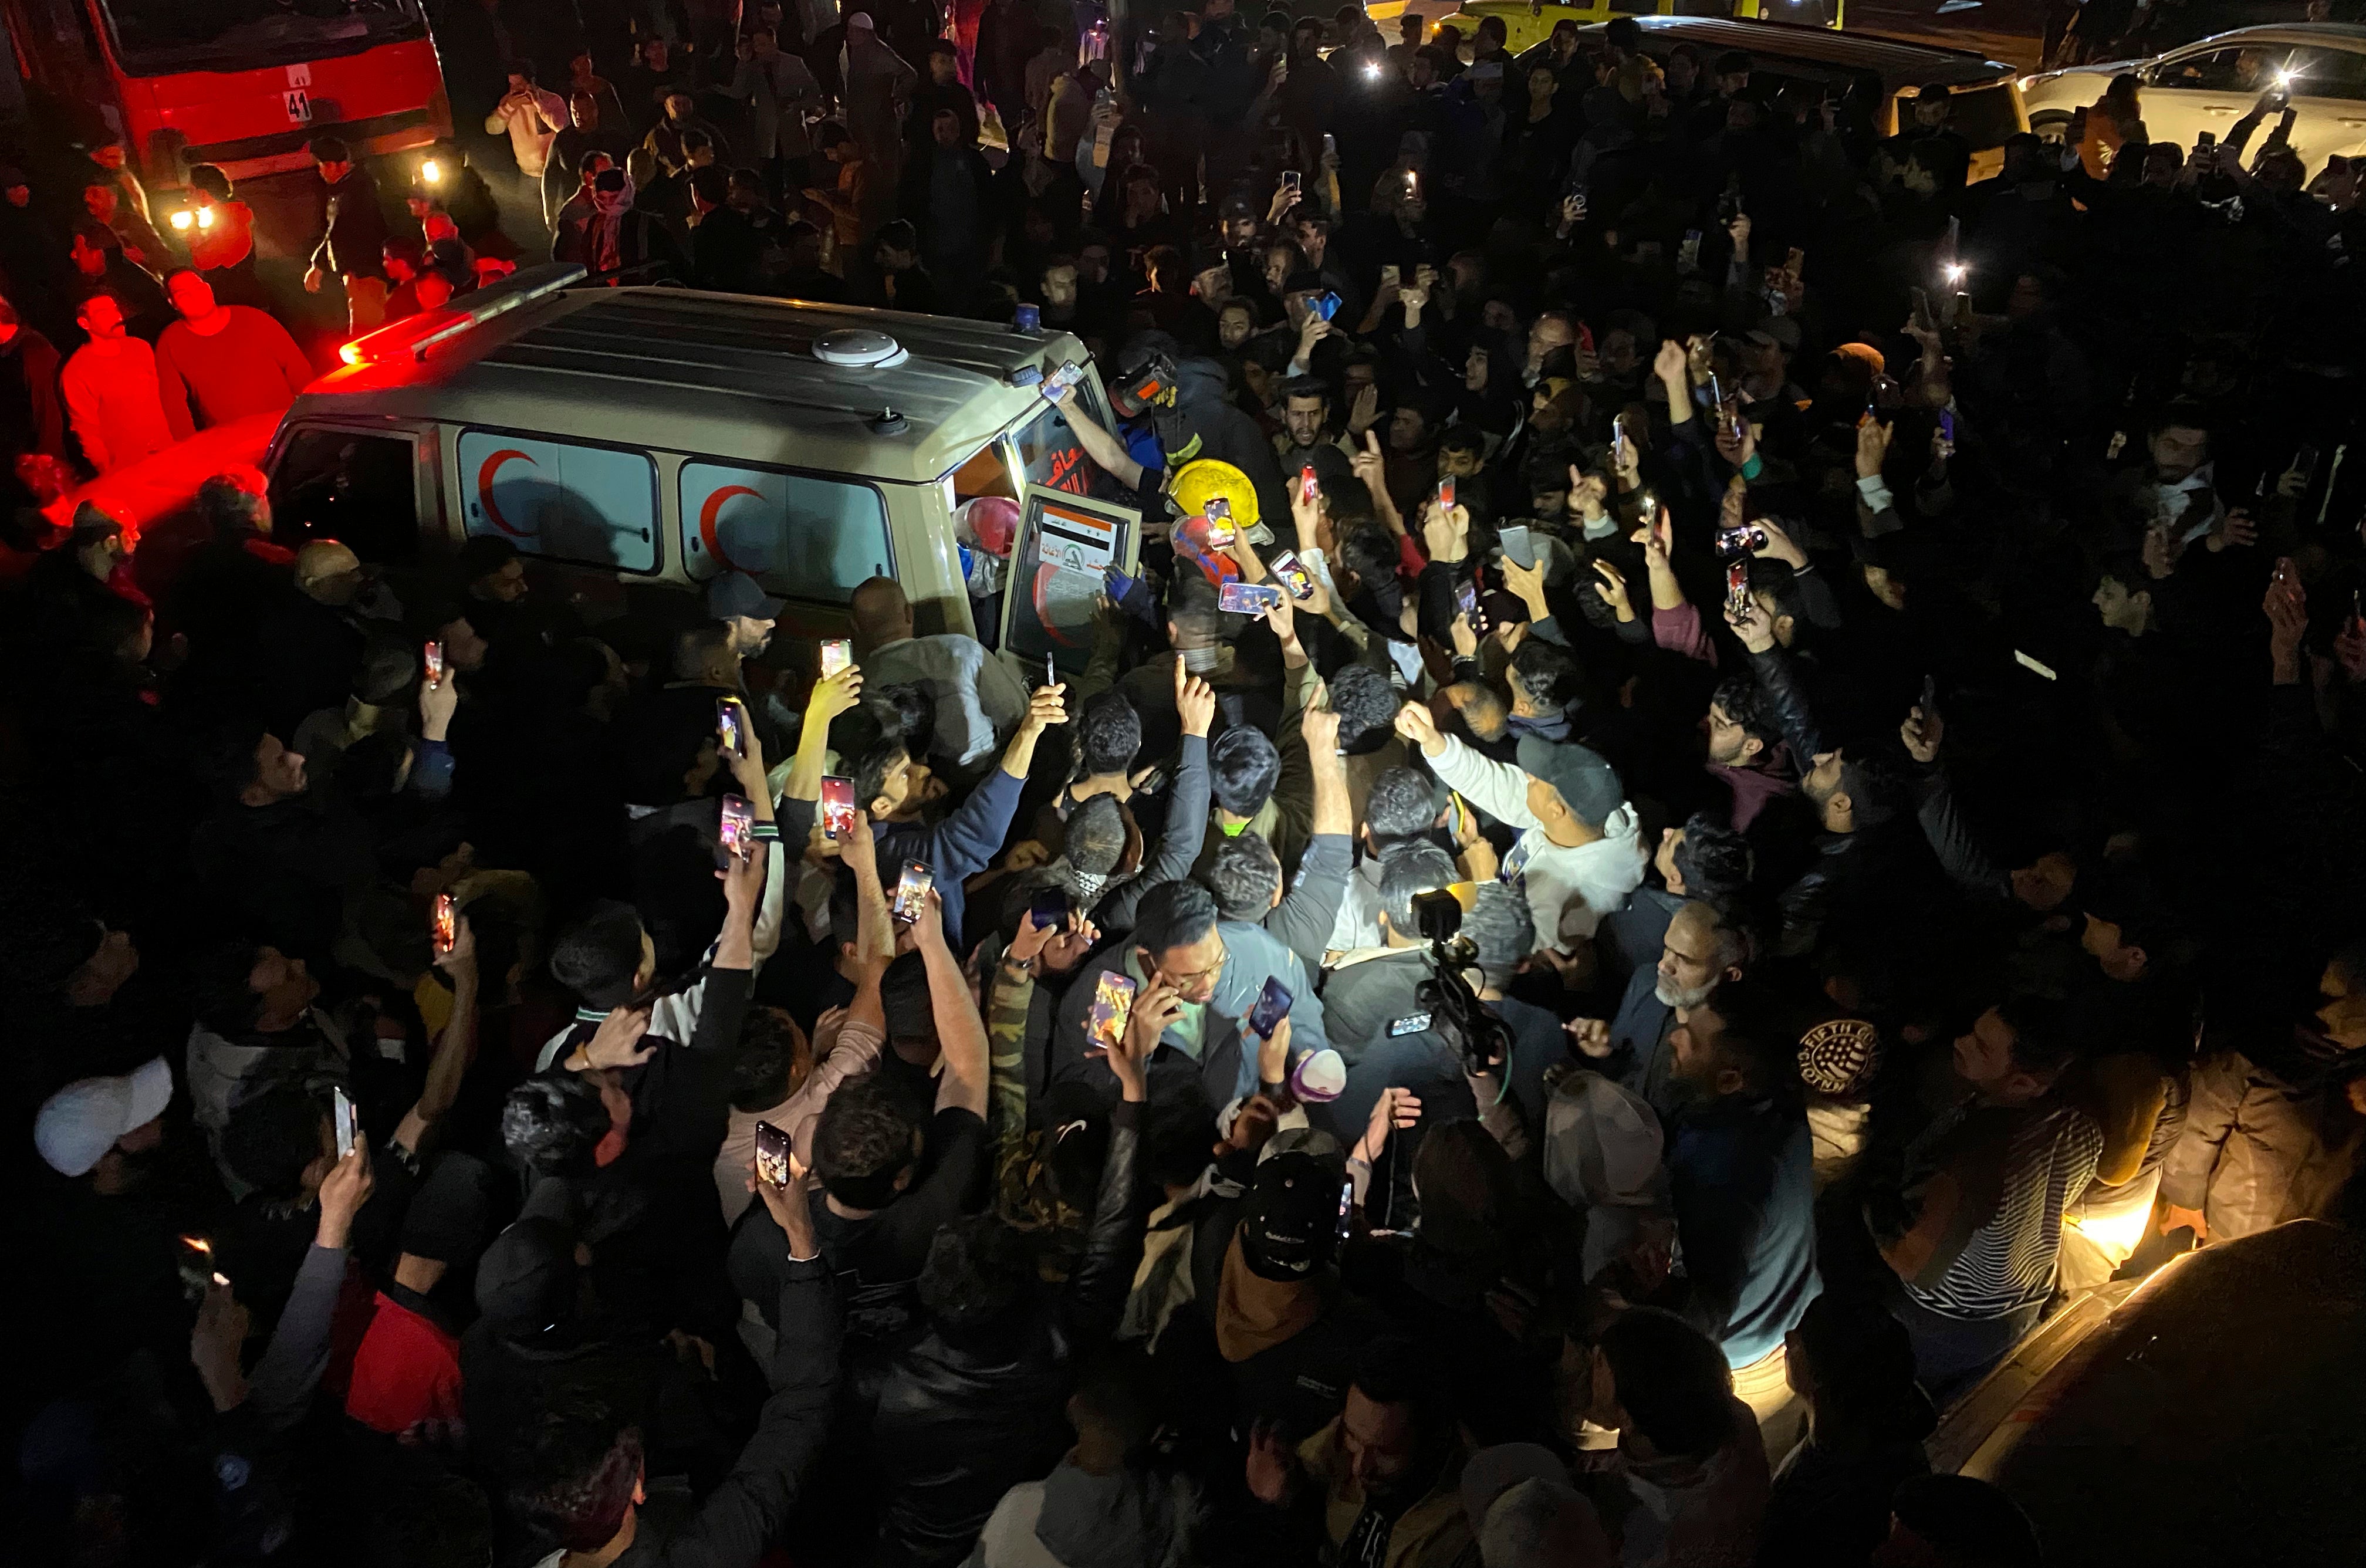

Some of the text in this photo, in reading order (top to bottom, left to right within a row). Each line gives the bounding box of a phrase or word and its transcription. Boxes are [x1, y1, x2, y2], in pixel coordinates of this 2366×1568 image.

[295, 77, 306, 86] 41
[289, 93, 309, 118] 41
[1804, 1024, 1851, 1047] FIFTH
